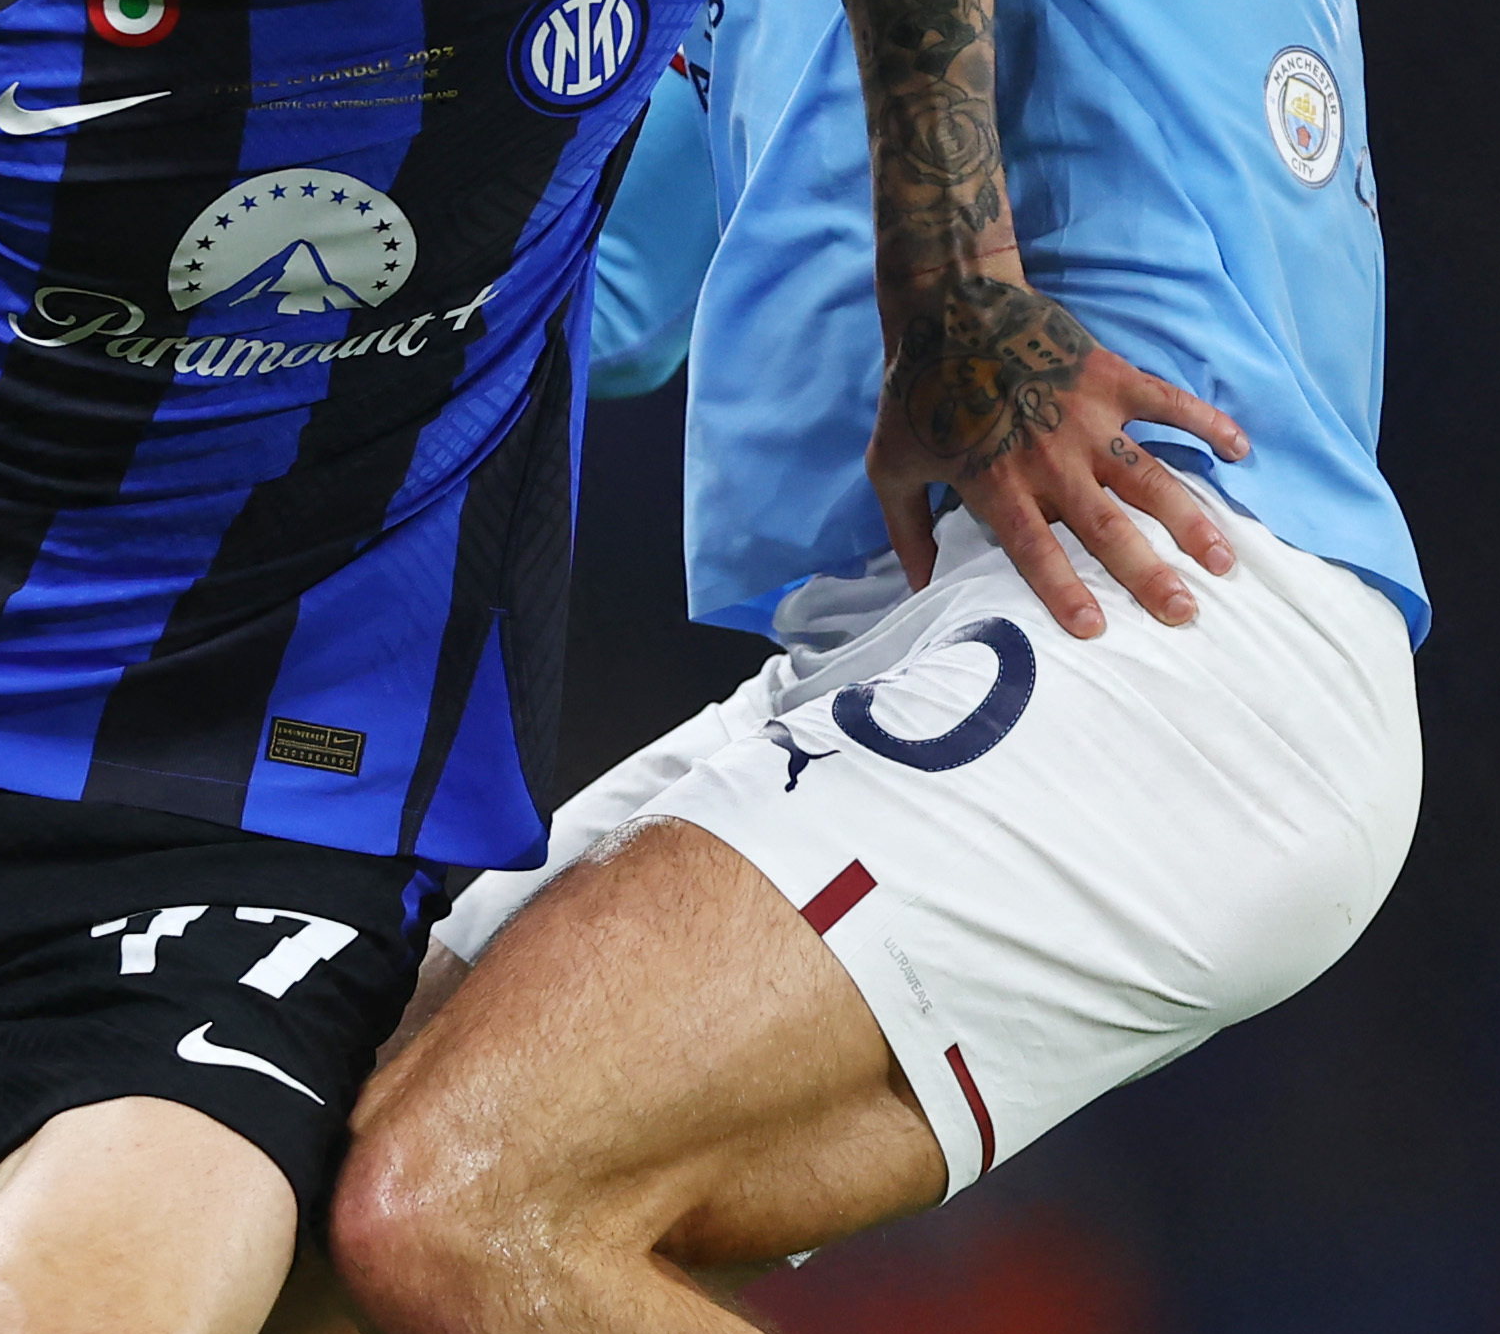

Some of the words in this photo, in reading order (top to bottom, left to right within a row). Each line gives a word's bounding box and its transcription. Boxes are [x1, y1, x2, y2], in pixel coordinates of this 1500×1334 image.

[402, 45, 456, 68] 2023
[1273, 56, 1338, 116] MANCHESTER
[1291, 158, 1315, 179] CITY
[90, 904, 360, 1000] 77
[882, 936, 934, 1016] ULTRAWEAVE
